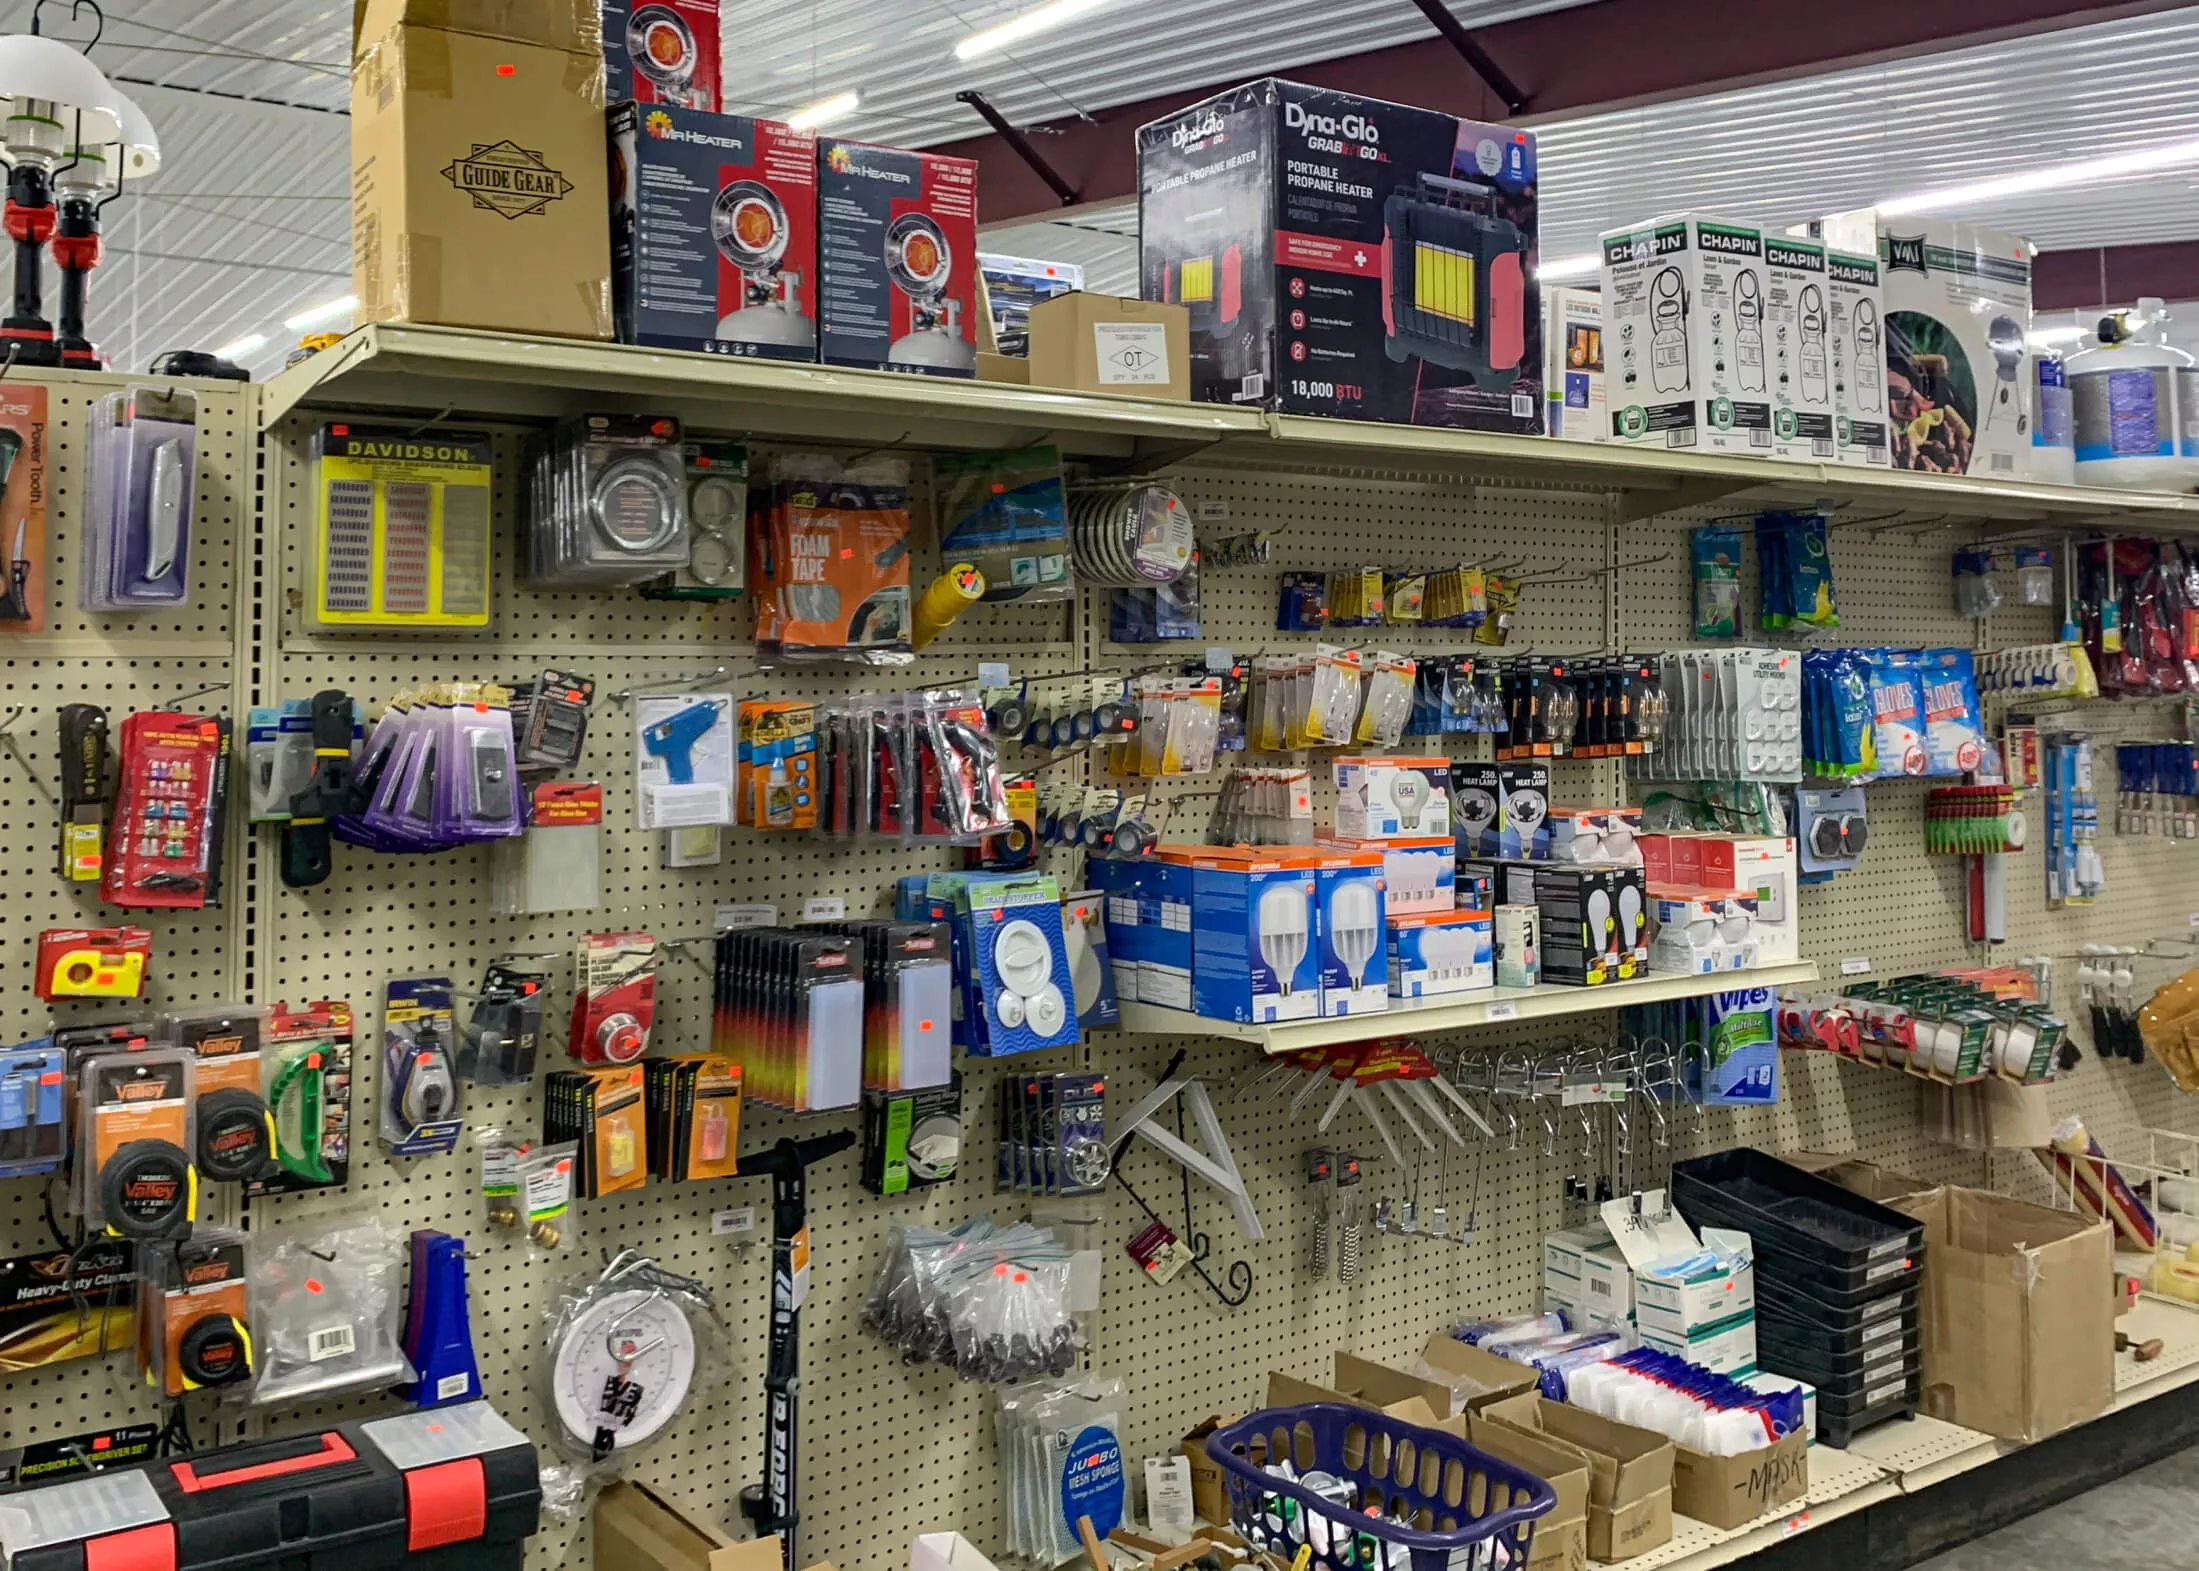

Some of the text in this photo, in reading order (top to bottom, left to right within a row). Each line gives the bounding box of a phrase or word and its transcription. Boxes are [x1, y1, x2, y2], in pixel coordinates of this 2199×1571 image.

[1285, 101, 1379, 143] Dyna-Glo
[685, 130, 742, 150] HEATER
[861, 166, 911, 184] HEATER
[1189, 161, 1225, 181] PROPANE
[1226, 150, 1257, 169] HEATER
[1288, 160, 1339, 180] PORTABLE
[463, 164, 555, 194] GUIDE GEAR
[1288, 173, 1373, 199] PROPANE HEATER
[1610, 235, 1681, 260] CHAPIN
[1701, 233, 1757, 253] CHAPIN
[1768, 250, 1821, 268] CHAPIN
[1291, 380, 1362, 400] 18,000 BTU
[31, 422, 44, 458] Power
[347, 441, 469, 462] DAVIDSON
[790, 533, 830, 558] FOAM
[791, 558, 825, 581] TAPE
[1874, 681, 1914, 714] GLOVES
[1433, 768, 1448, 776] LED
[1462, 777, 1498, 786] HEAT LAMP
[1515, 778, 1548, 786] HEAT LAMP
[1399, 785, 1415, 795] USA
[1300, 870, 1315, 879] LED
[1370, 867, 1384, 876] LED
[196, 1036, 244, 1053] Valley
[115, 1080, 168, 1099] Valley
[209, 1127, 257, 1152] Valley
[125, 1181, 178, 1200] Valley
[185, 1262, 230, 1282] Valley
[115, 1431, 126, 1441] 11
[21, 1459, 67, 1475] PRECISION
[131, 1443, 148, 1456] SET
[1067, 1446, 1119, 1475] JUBO
[1091, 1459, 1120, 1482] SPONGE
